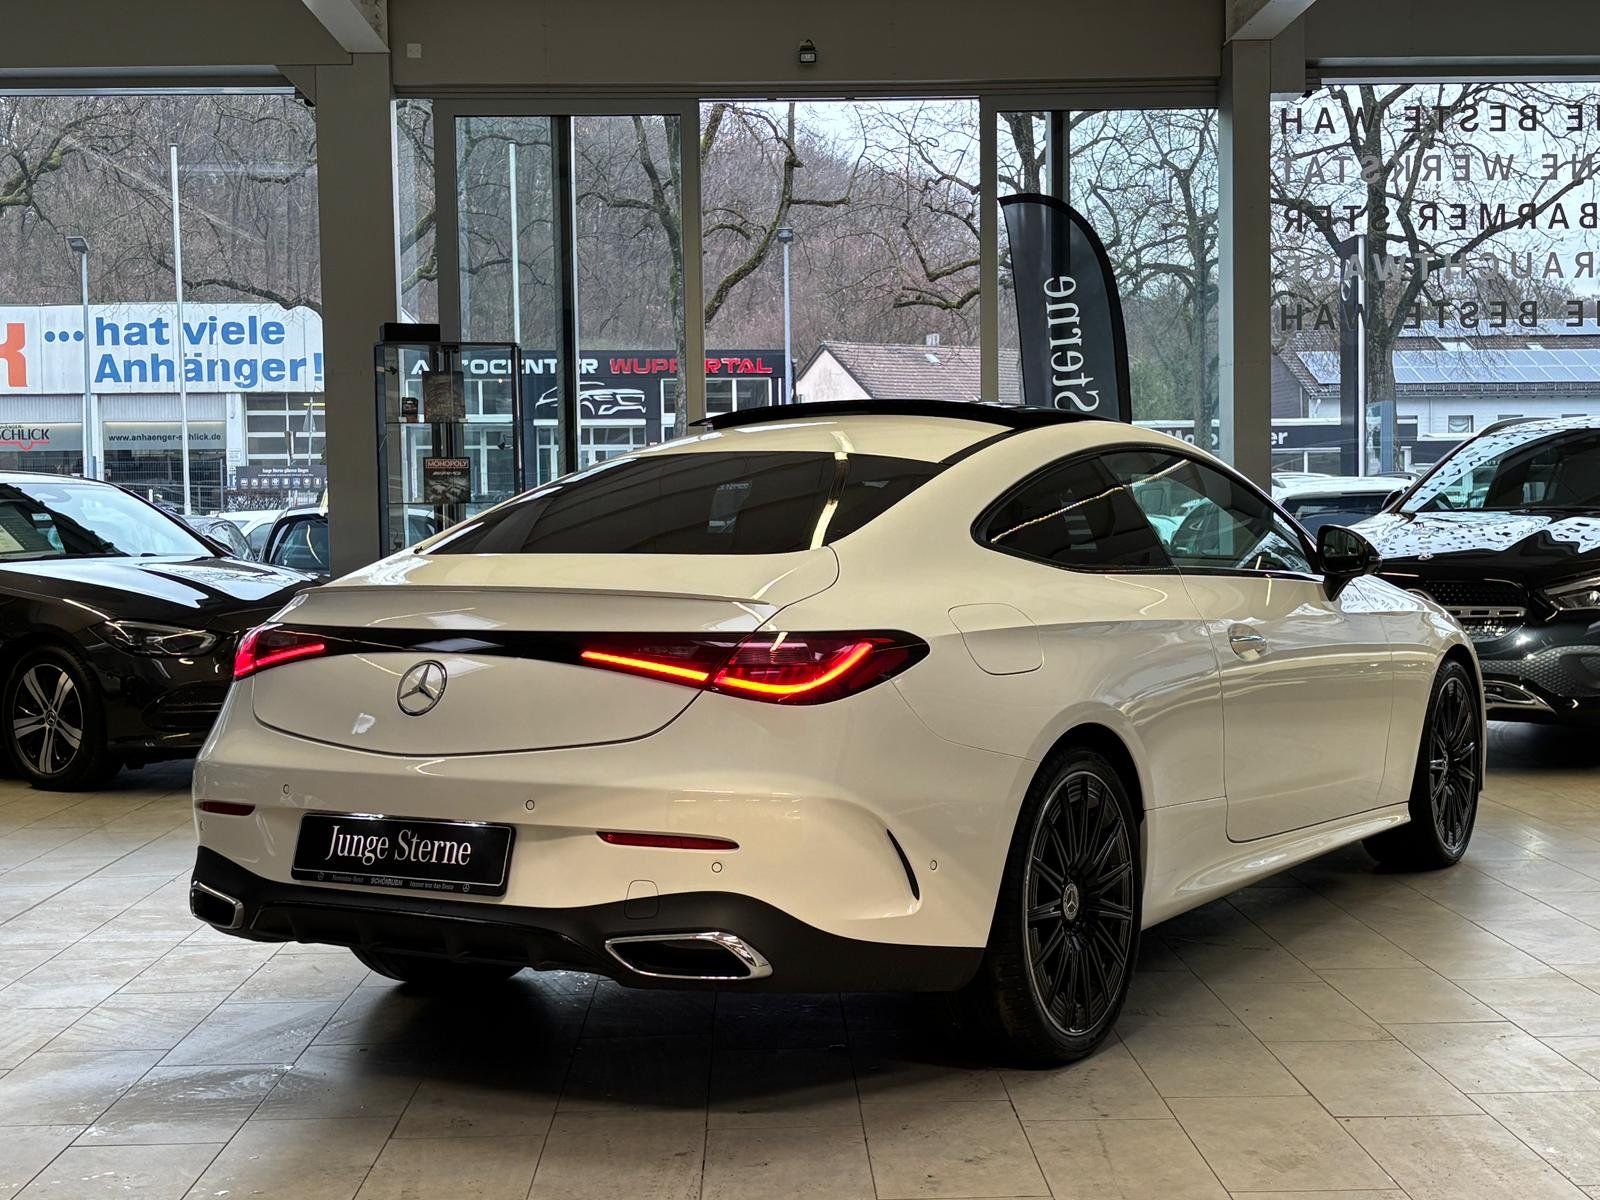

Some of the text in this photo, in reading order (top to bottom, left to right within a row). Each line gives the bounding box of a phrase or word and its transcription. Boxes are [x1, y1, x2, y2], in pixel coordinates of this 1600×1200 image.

[95, 317, 170, 346] hat
[183, 316, 285, 345] viele
[94, 352, 323, 389] Anhänger!
[0, 428, 50, 441] CHLICK
[108, 433, 222, 443] www.anhaenger-shlick.de
[427, 459, 468, 468] MONOPOLY
[325, 825, 472, 866] Junge Sterne
